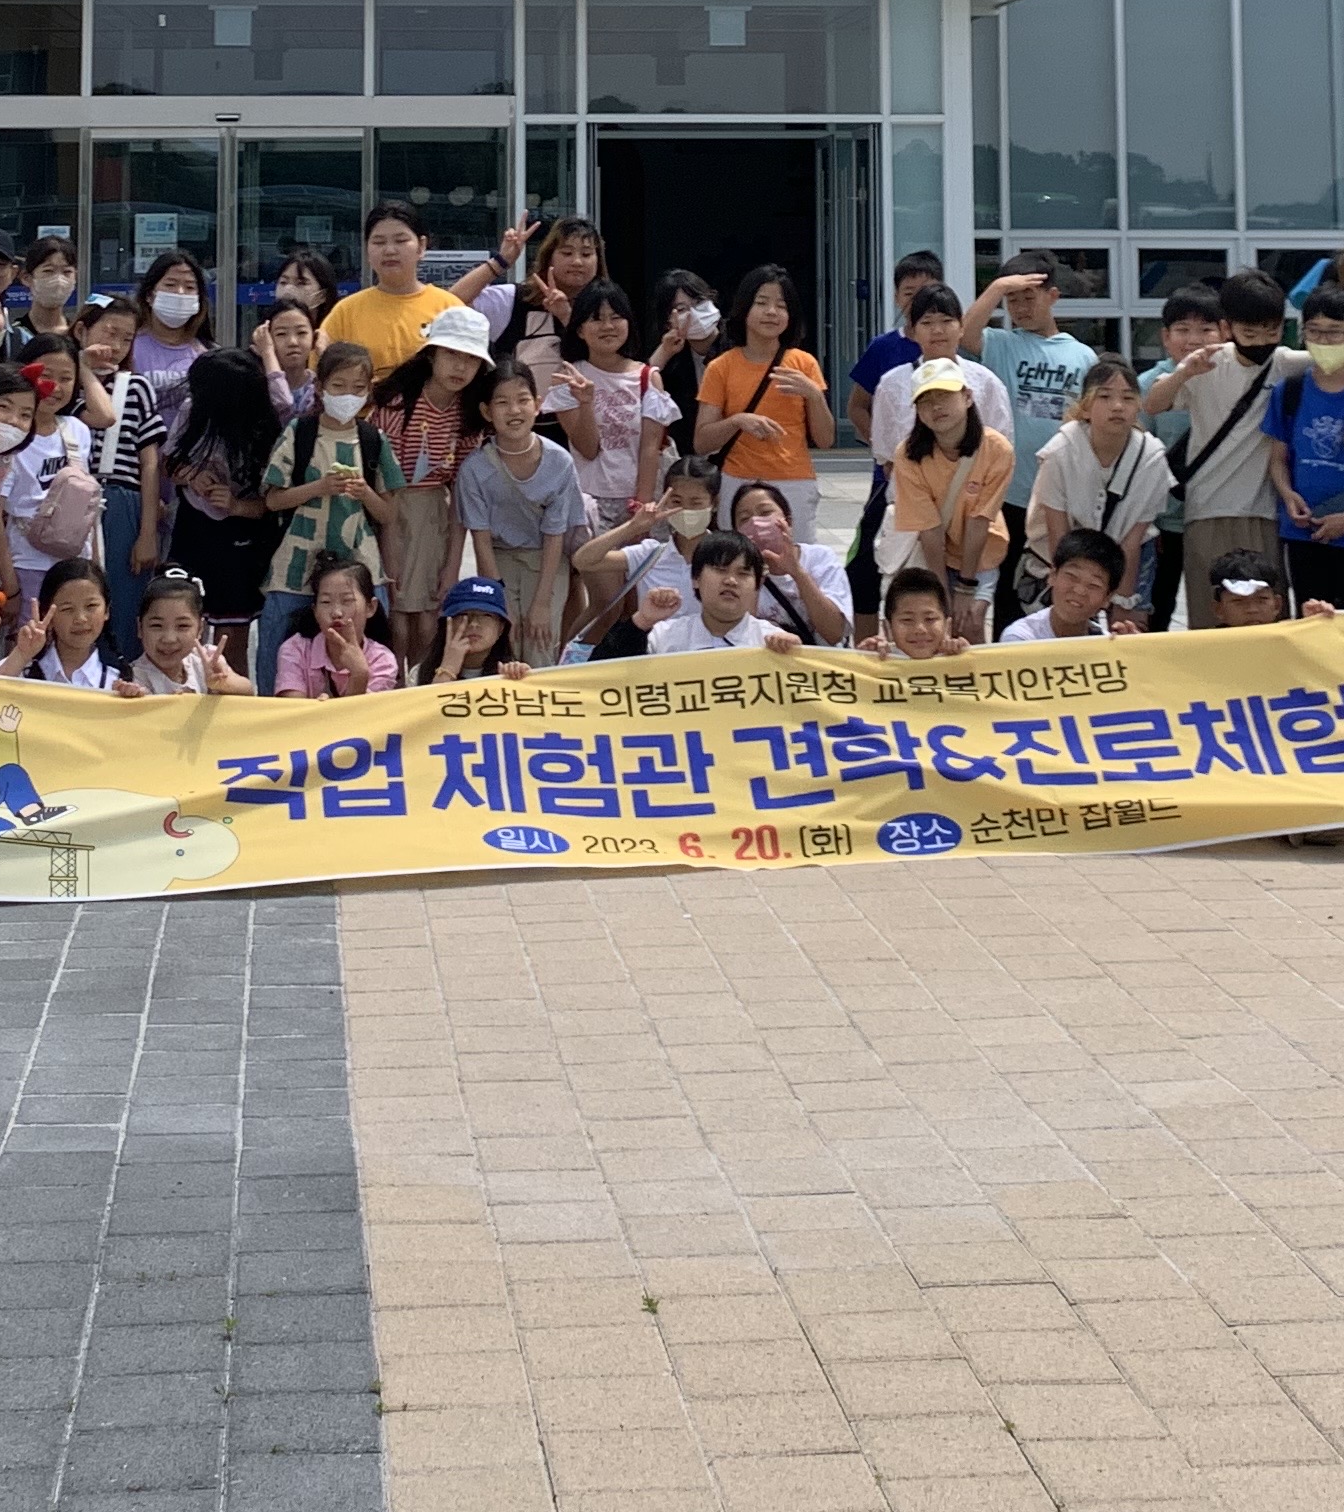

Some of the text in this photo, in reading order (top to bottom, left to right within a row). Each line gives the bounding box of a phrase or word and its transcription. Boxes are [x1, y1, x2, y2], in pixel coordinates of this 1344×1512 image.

[1017, 360, 1080, 391] CENTRAL
[437, 660, 1129, 719] 경상남도 의령교육지원청 교육복지안전망
[217, 732, 407, 820] 직업
[429, 731, 716, 818] 체험관
[496, 827, 558, 852] 일시
[678, 832, 716, 859] 6.
[731, 824, 793, 861] 20.
[799, 823, 854, 859] (화)
[886, 817, 956, 853] 장소
[970, 807, 1070, 845] 순천만
[1079, 797, 1182, 831] 잡월드
